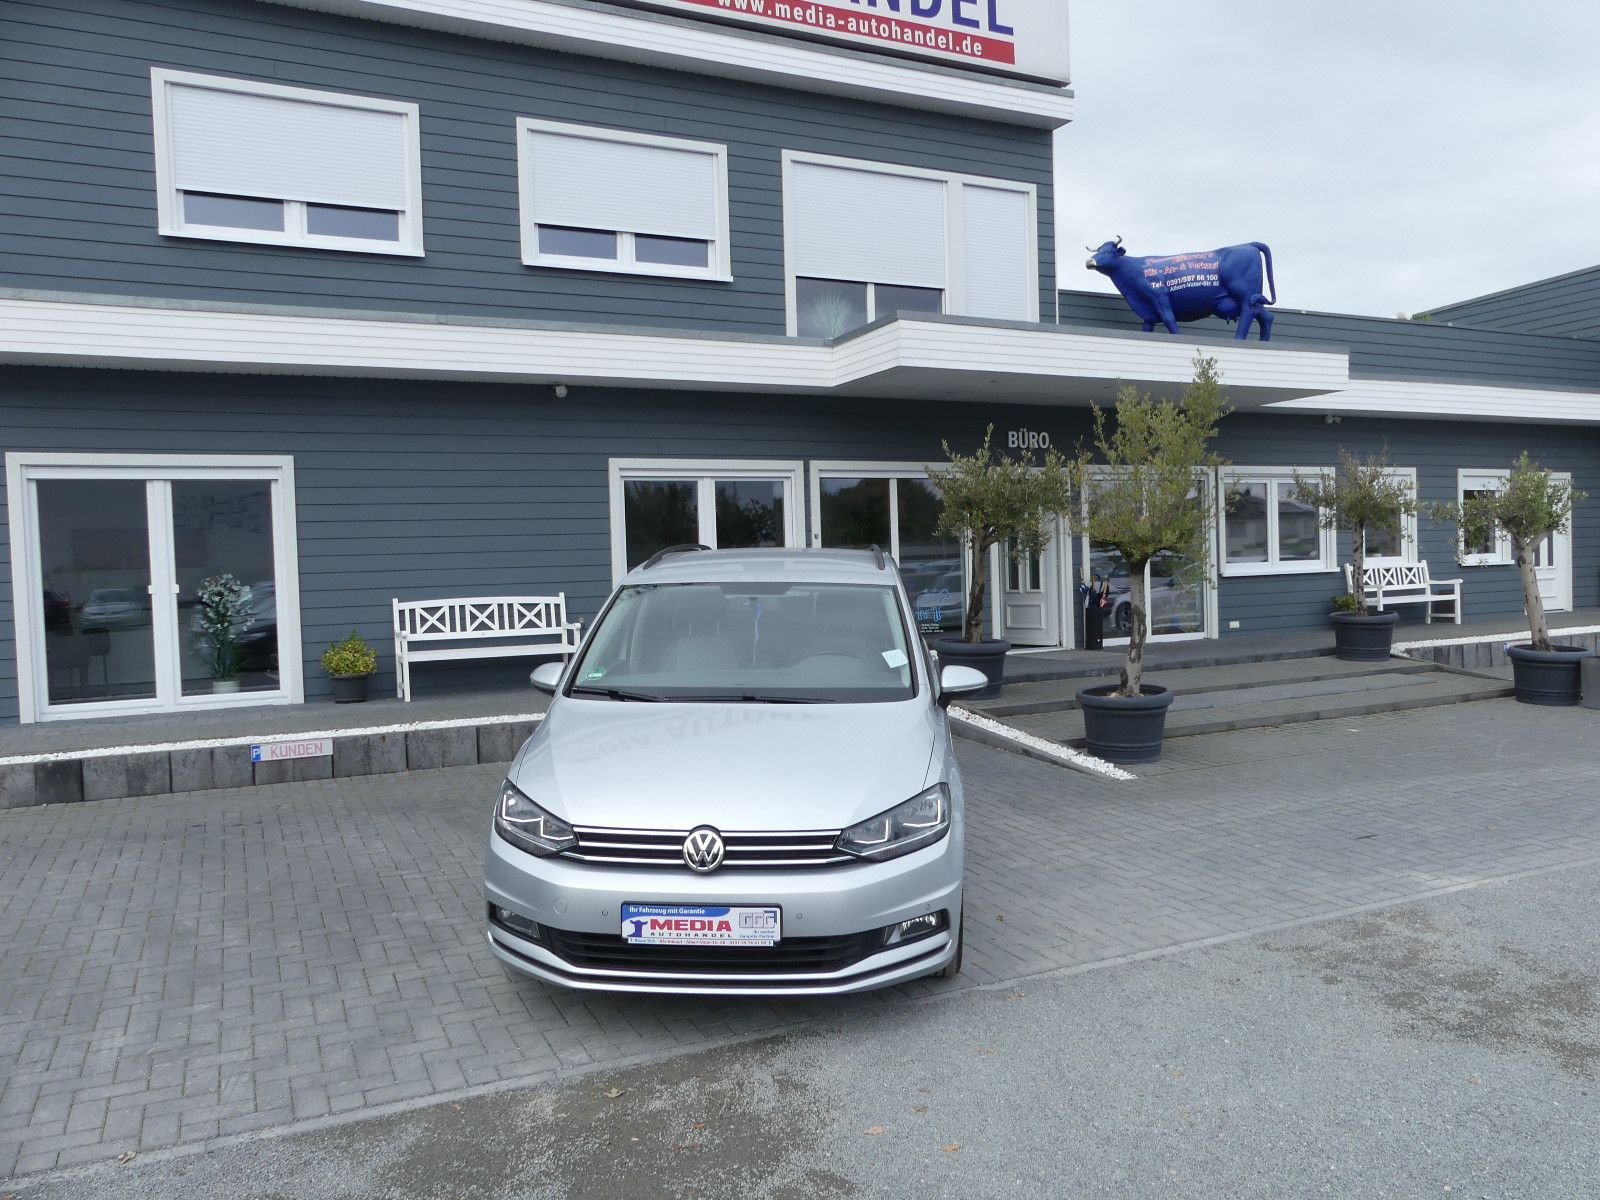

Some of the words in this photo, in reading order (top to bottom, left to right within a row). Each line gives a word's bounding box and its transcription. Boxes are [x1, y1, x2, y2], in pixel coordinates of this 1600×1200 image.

[717, 0, 982, 56] www.media-autohandel.de
[1008, 428, 1050, 449] BÜRO
[252, 748, 261, 759] P
[270, 742, 323, 758] KUNDEN
[640, 907, 667, 915] Fahrzeug
[679, 907, 706, 915] Garantie
[650, 918, 733, 932] MEDIA
